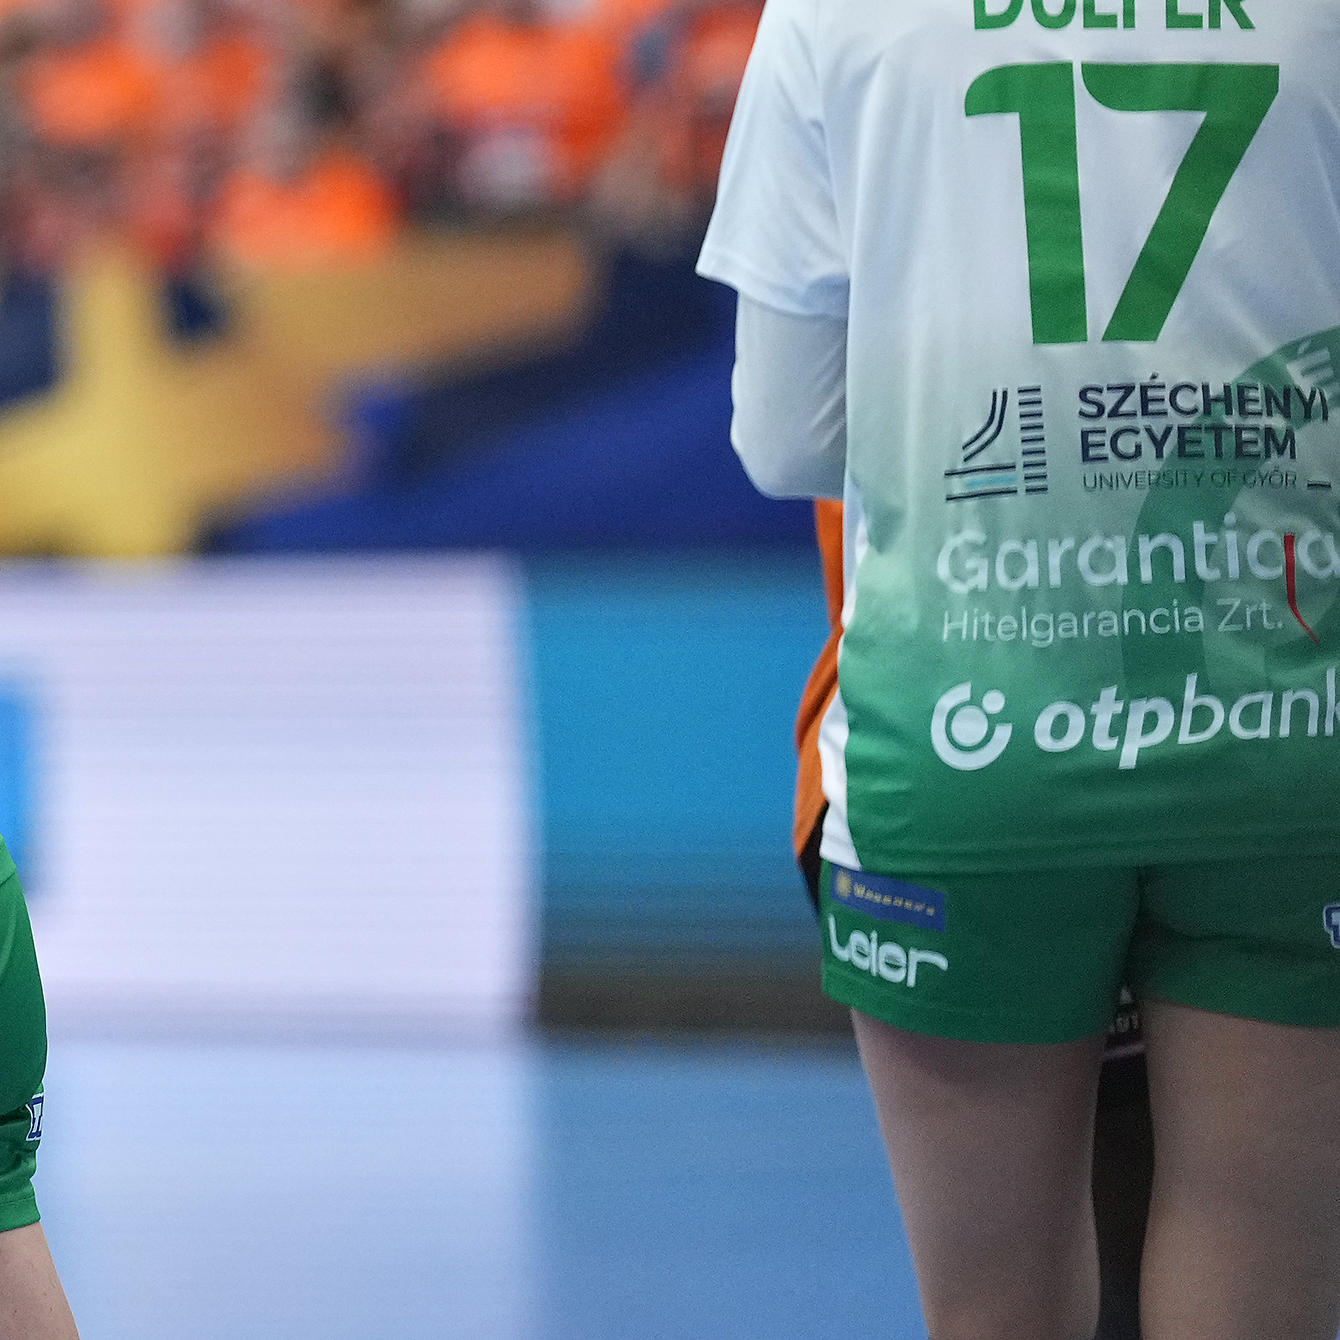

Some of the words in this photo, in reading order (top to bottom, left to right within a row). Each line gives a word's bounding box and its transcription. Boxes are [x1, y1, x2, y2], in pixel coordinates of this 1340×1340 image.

[964, 61, 1280, 344] 17
[1078, 372, 1329, 421] SZÉCHENYI
[1081, 424, 1298, 462] EGYETEM
[1083, 469, 1203, 492] UNIVERSITY
[1210, 470, 1239, 489] OF
[942, 599, 1205, 648] Hitelgarancia
[1218, 596, 1285, 633] Zrt.
[828, 913, 949, 988] Leier
